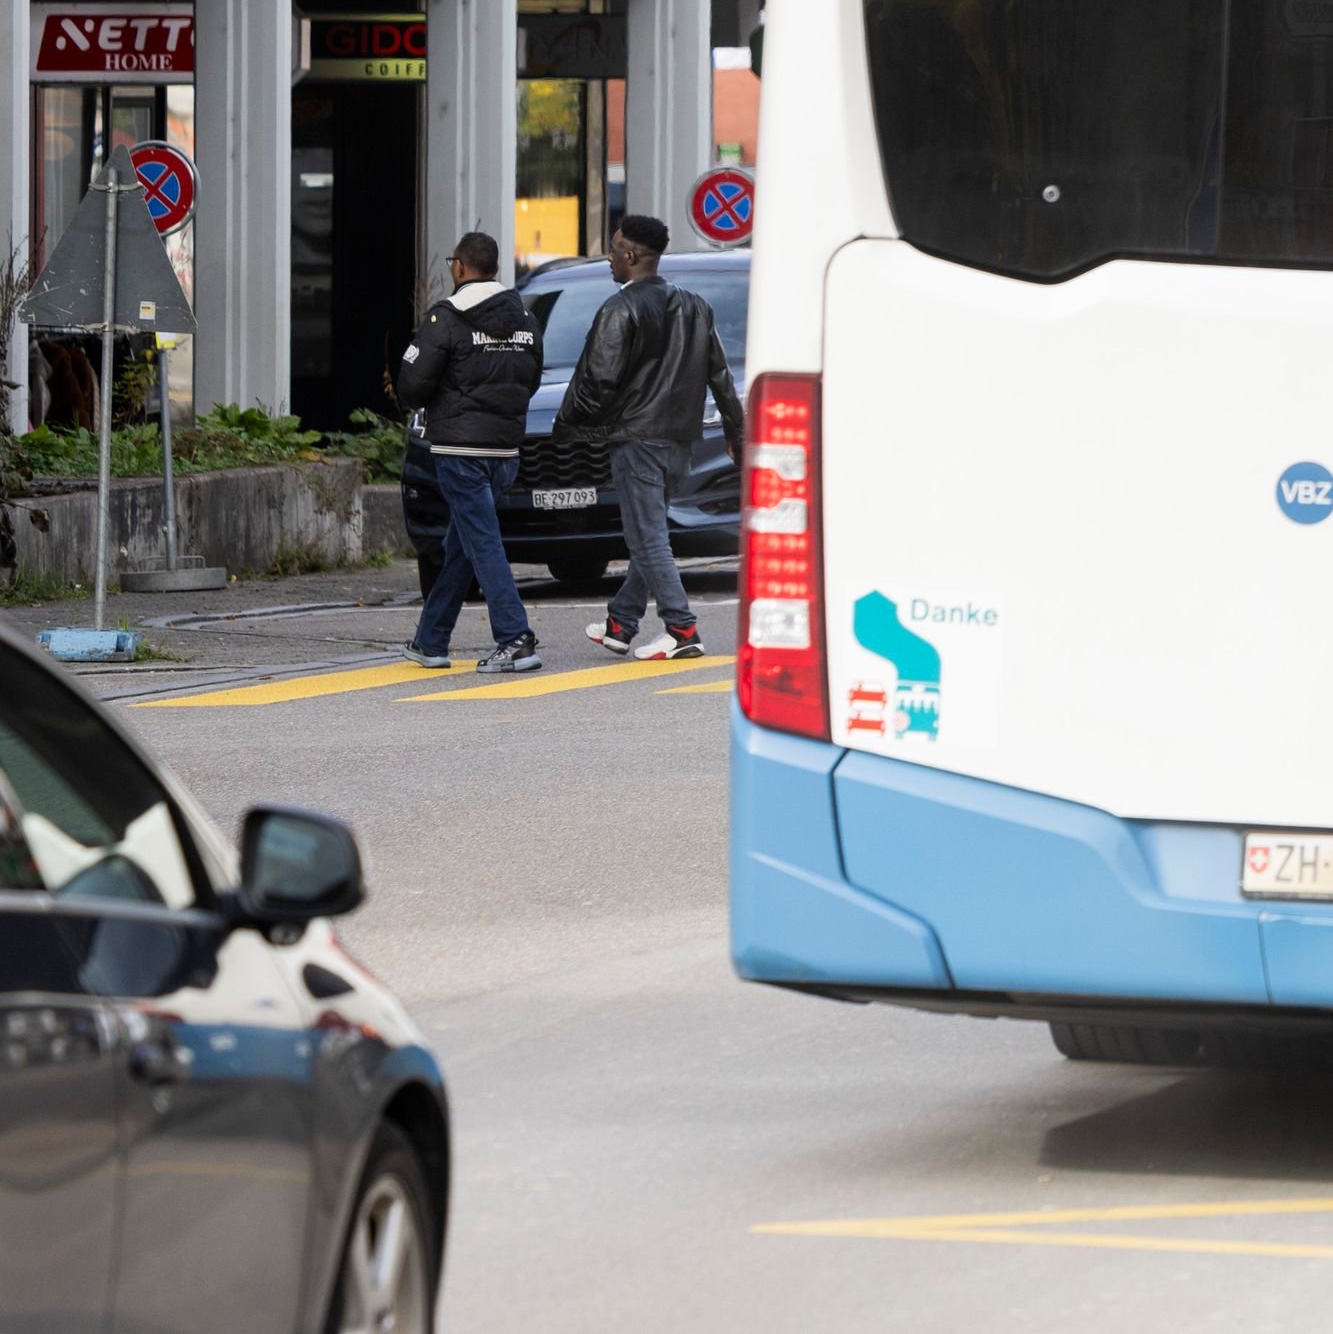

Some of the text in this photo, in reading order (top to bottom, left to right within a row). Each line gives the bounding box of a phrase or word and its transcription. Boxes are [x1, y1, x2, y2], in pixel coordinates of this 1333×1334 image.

[56, 18, 194, 52] NETT
[105, 53, 173, 71] HOME
[472, 331, 507, 345] MAR
[1280, 479, 1333, 506] VBZ
[910, 598, 999, 627] Danke
